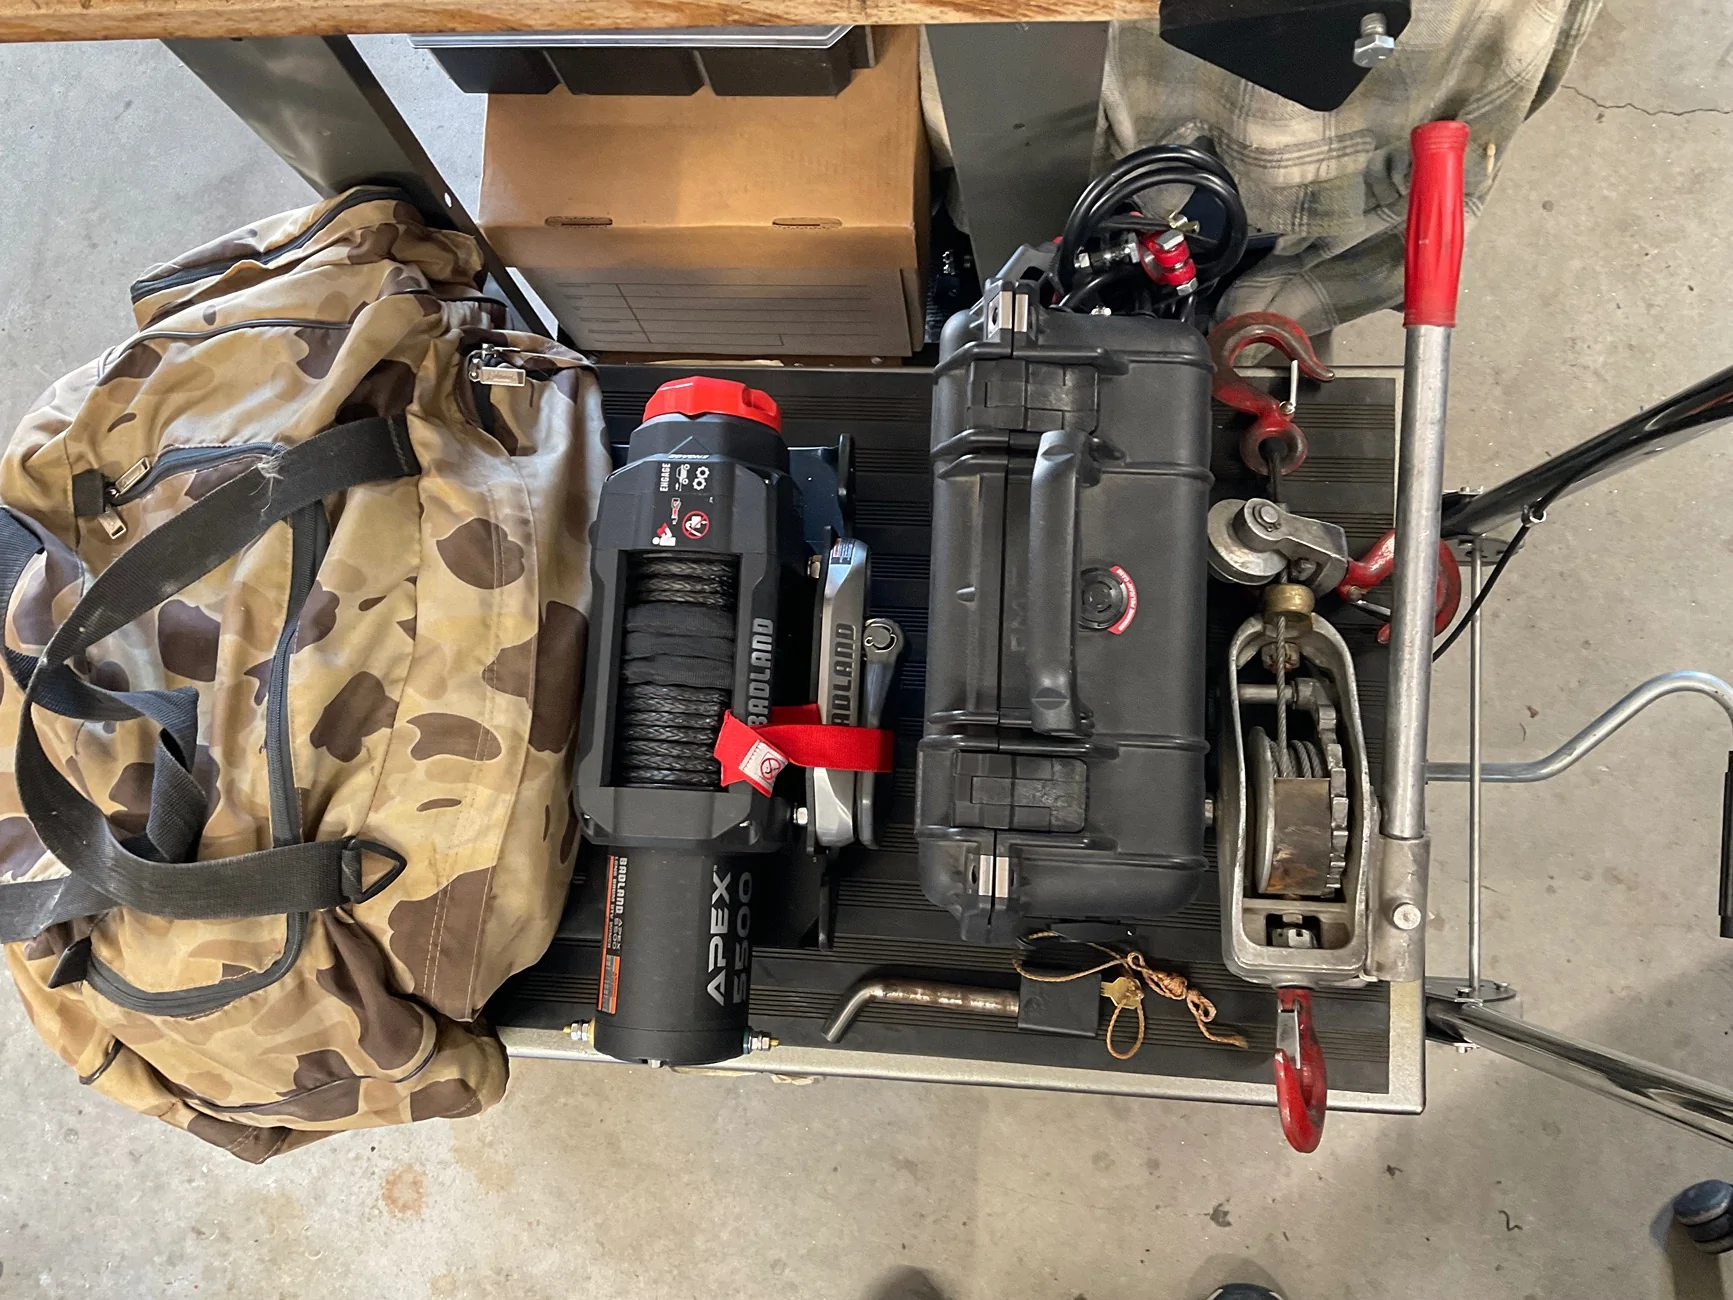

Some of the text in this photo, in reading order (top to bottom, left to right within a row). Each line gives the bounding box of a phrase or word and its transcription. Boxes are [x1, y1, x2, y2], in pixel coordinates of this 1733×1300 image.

[660, 463, 671, 492] ENGAGE
[747, 618, 773, 726] BADLAND
[831, 623, 856, 726] ADLAND
[615, 857, 628, 914] BADLAND
[733, 871, 753, 1004] 5500
